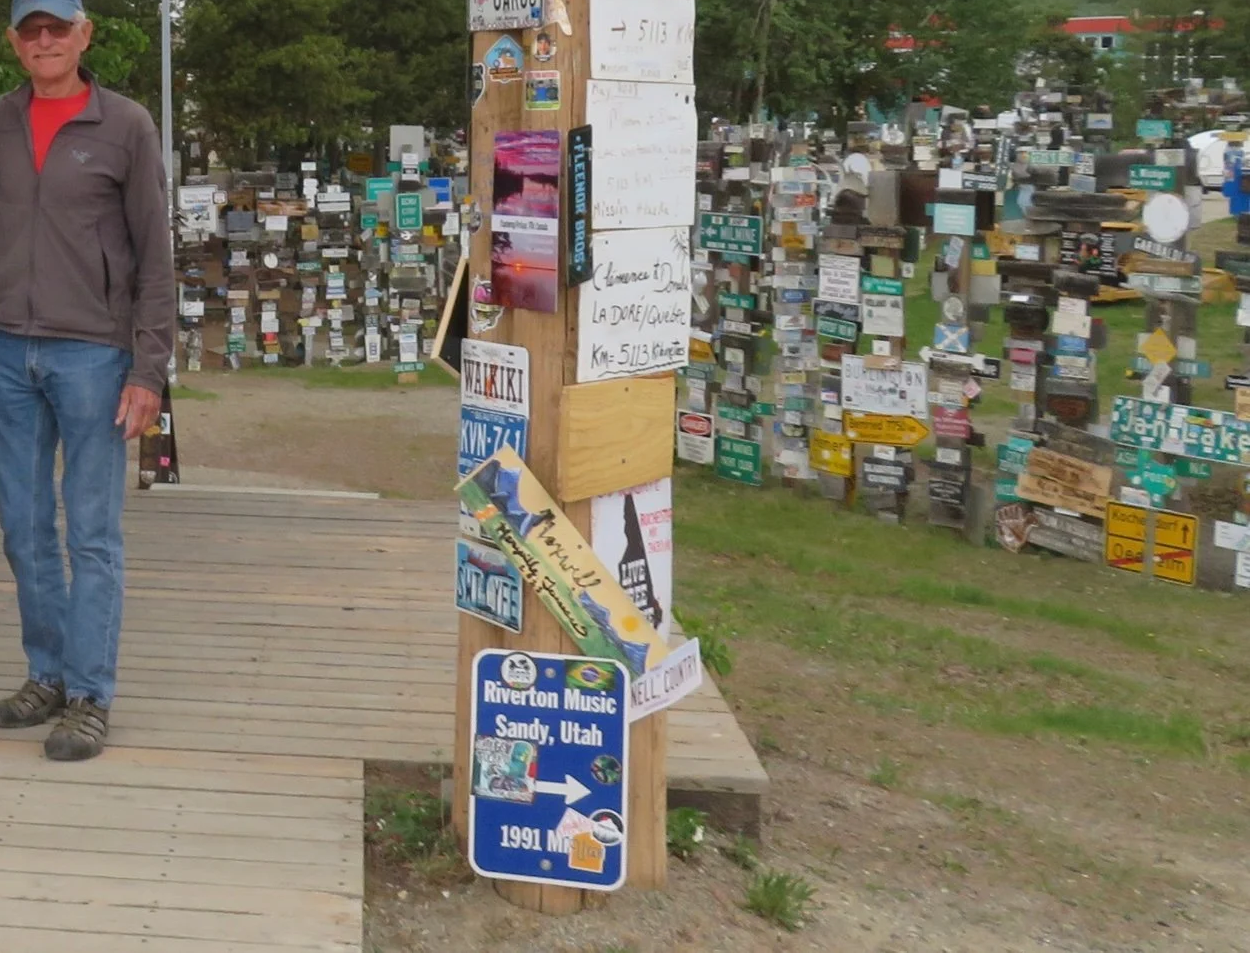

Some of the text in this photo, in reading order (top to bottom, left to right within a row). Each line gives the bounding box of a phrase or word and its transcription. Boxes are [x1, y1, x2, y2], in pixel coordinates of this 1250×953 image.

[572, 143, 588, 264] FLEENOR BROS
[463, 358, 524, 404] WAIKIKI
[1118, 410, 1250, 453] Jan Lake
[483, 679, 617, 715] Riverton Music
[495, 714, 603, 747] Sandy, Utah
[500, 824, 543, 852] 1991
